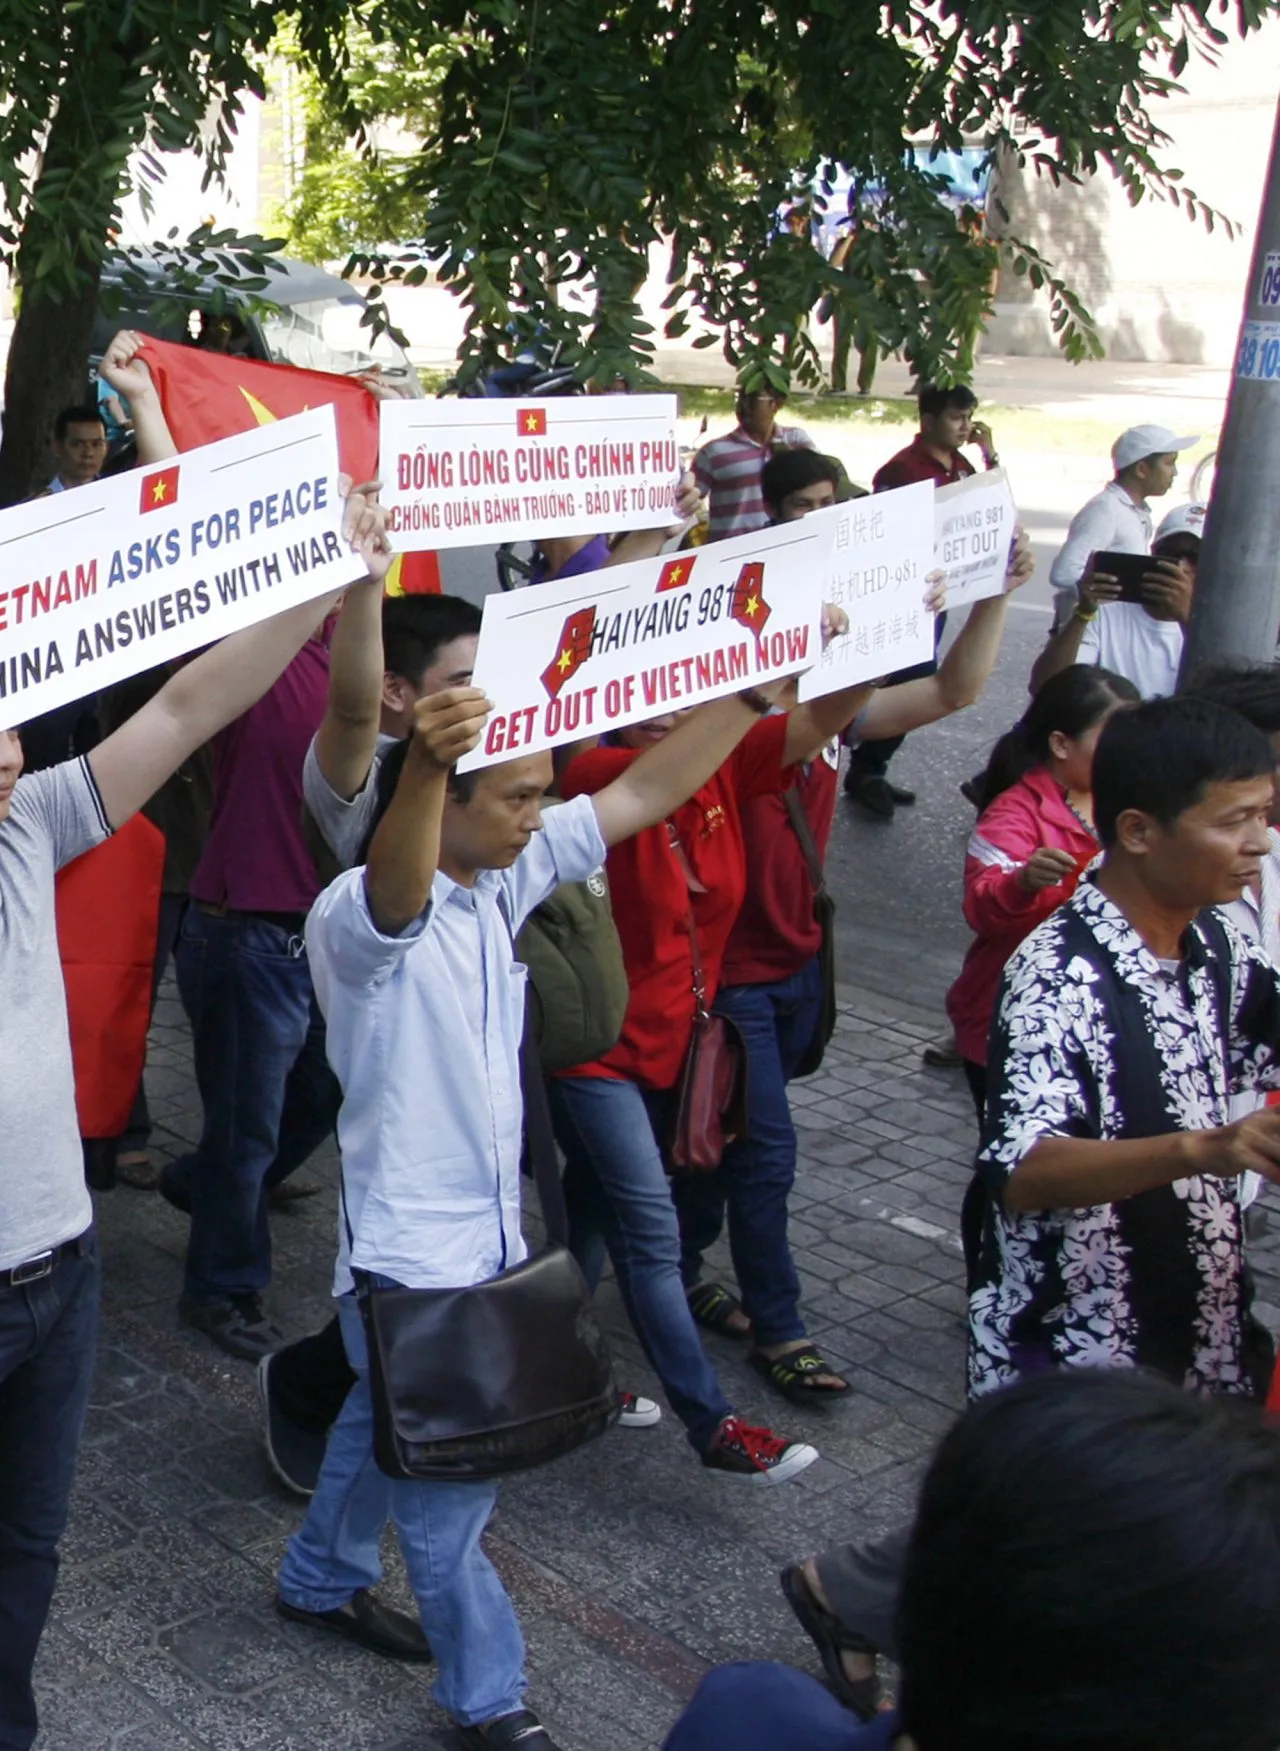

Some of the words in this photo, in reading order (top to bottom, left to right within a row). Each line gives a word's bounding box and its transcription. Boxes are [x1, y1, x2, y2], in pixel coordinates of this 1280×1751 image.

[397, 443, 454, 491] ĐỒNG
[459, 442, 510, 487] LÒNG
[515, 440, 569, 483] CÙNG
[575, 437, 635, 479] CHÍNH
[640, 429, 676, 474] PHỦ
[107, 529, 181, 588] ASKS
[191, 507, 240, 556] FOR
[249, 476, 329, 535] PEACE
[443, 496, 481, 530] QUÂN
[484, 493, 520, 524] BÀNH
[986, 504, 1004, 525] 981
[943, 537, 967, 563] GET
[972, 528, 999, 555] OUT
[75, 580, 211, 668] ANSWERS
[215, 553, 281, 607] WITH
[286, 530, 343, 578] WAR
[589, 591, 691, 657] HAIYANG
[698, 584, 736, 627] 981
[484, 704, 539, 756] GET
[544, 687, 598, 737] OUT
[604, 674, 636, 718] OF
[640, 641, 750, 706] VIETNAM
[755, 624, 810, 670] NOW
